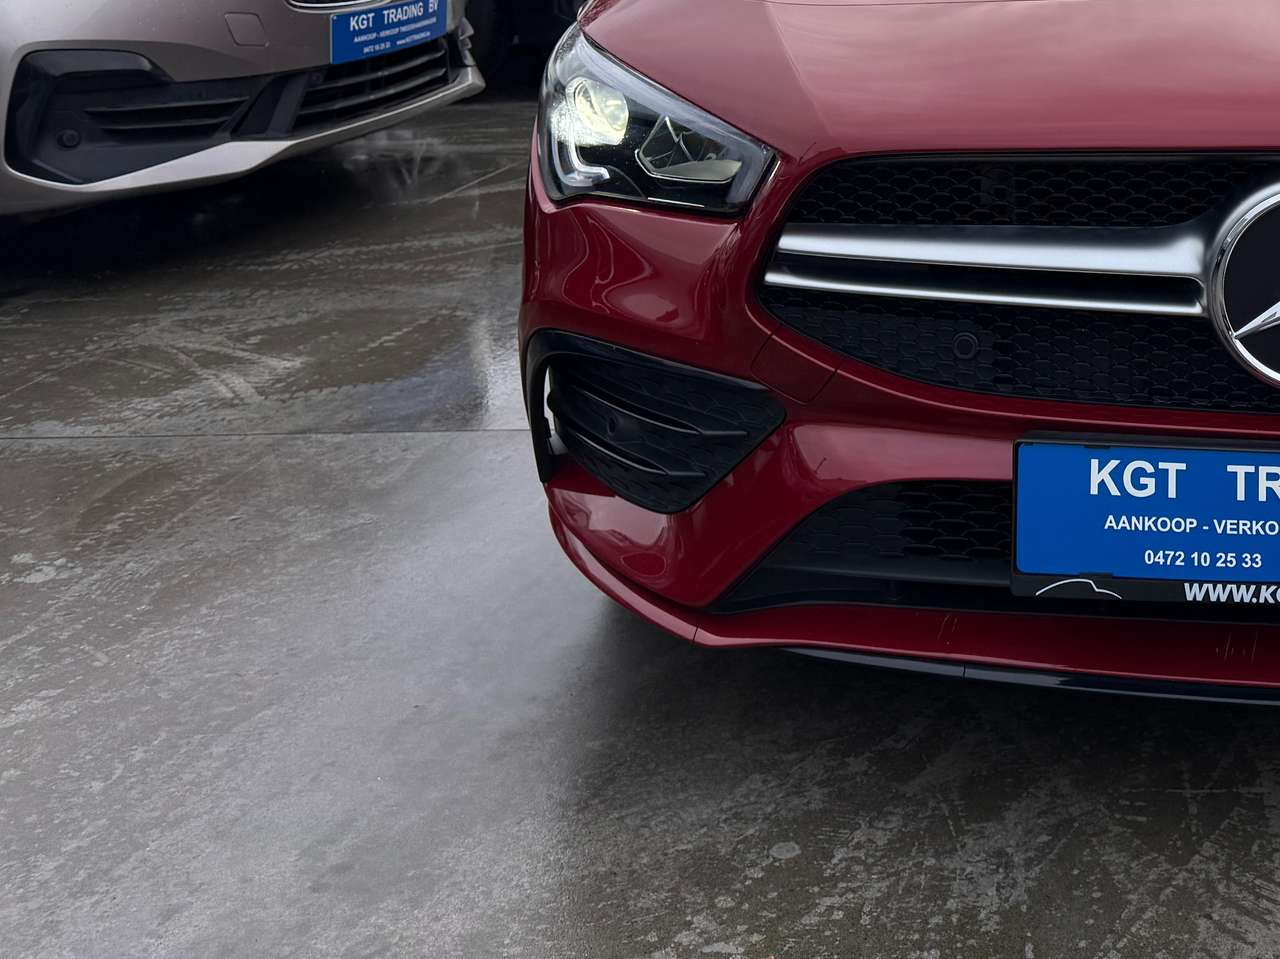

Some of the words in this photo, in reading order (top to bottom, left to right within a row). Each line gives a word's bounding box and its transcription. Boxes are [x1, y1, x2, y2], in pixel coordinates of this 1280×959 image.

[349, 13, 375, 32] KGT
[382, 2, 424, 25] TRADING
[1089, 458, 1187, 499] KGT
[1104, 515, 1198, 533] AANKOOP
[1144, 549, 1185, 566] 0472
[1190, 552, 1211, 567] 10
[1215, 552, 1237, 568] 25
[1241, 553, 1262, 568] 33
